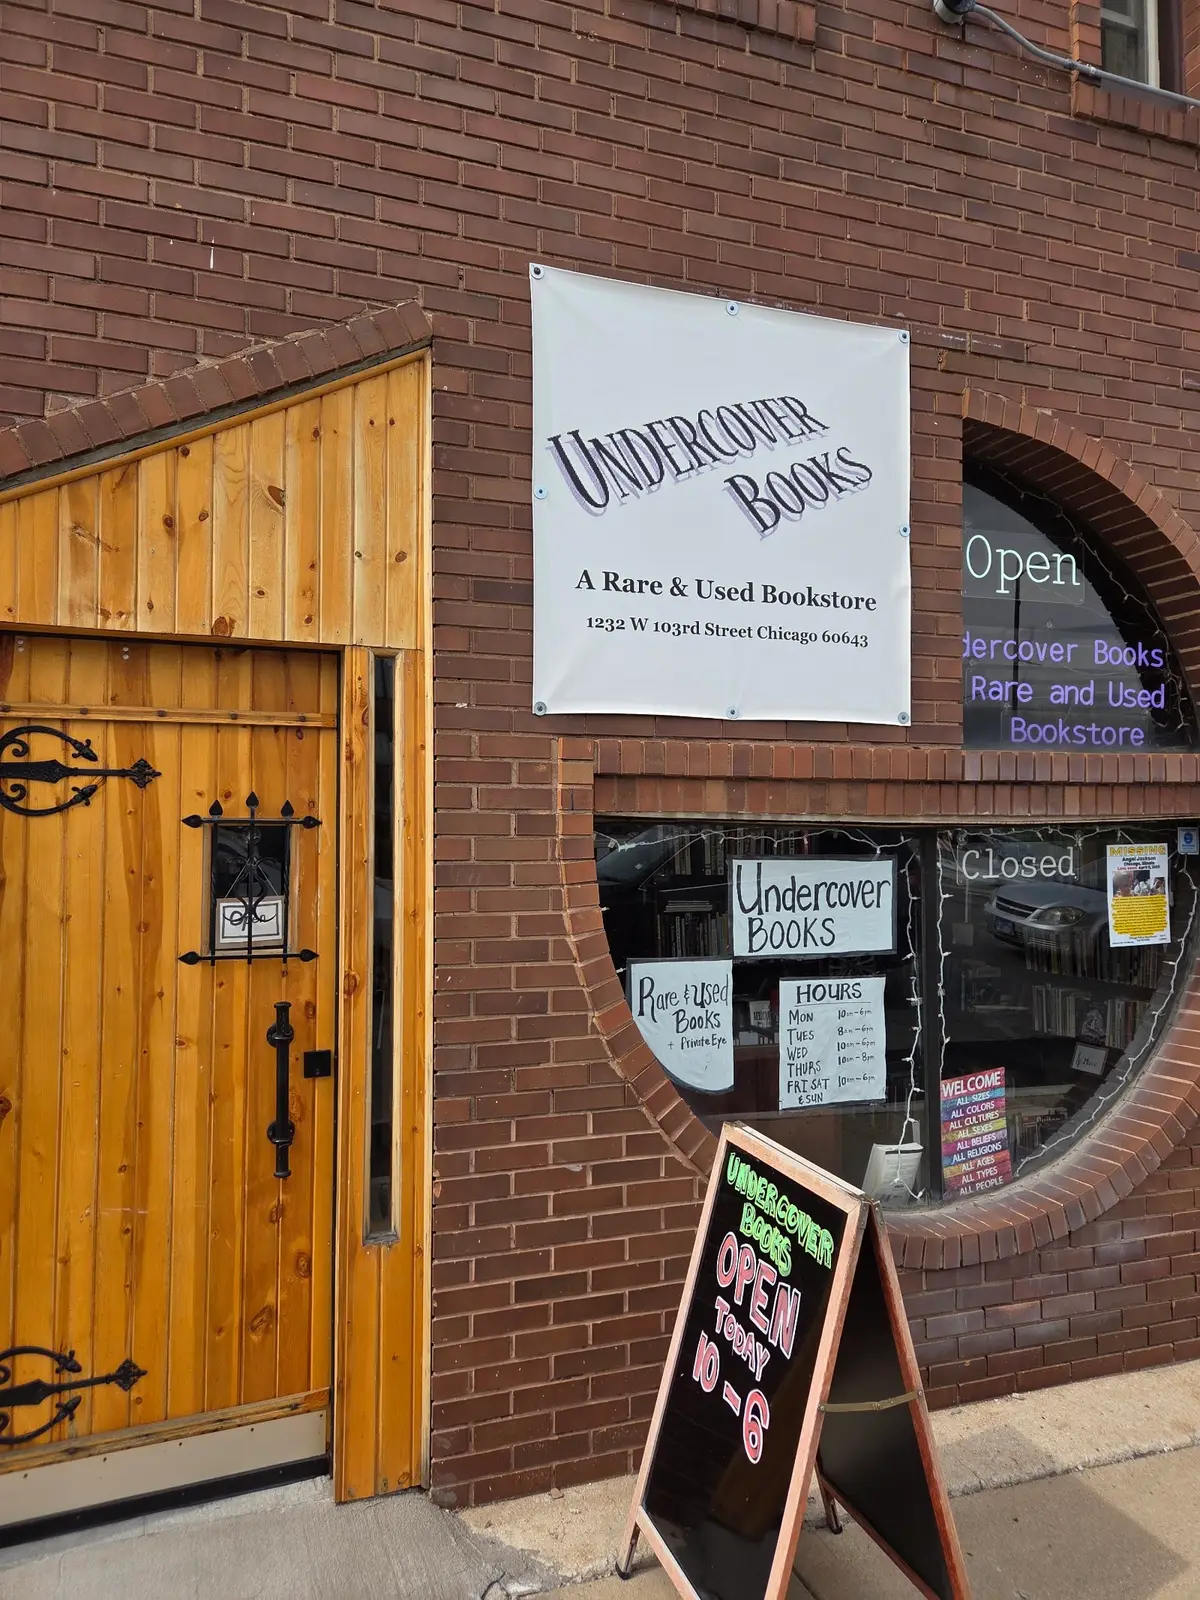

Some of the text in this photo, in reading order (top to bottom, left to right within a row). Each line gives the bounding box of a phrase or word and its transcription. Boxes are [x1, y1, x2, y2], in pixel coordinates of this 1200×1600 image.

[546, 396, 830, 512] UNDERCOVER
[722, 447, 872, 537] BOOKS
[966, 534, 1080, 593] Open
[575, 569, 878, 612] A Rare & Used Bookstore
[586, 616, 869, 649] 1232 W 103rd Street Chicago 60643
[1094, 639, 1164, 668] Books
[971, 675, 1165, 709] Rare and Used
[1010, 716, 1145, 747] Bookstore
[962, 846, 1076, 880] Closed
[1109, 845, 1166, 856] MISSING
[736, 862, 892, 916] Undercover
[748, 916, 836, 954] BOOKS
[637, 976, 680, 1023] Rare
[691, 974, 729, 1009] Used
[796, 982, 862, 1004] HOURS
[672, 1008, 721, 1034] Books
[787, 1046, 808, 1061] WED
[787, 1060, 821, 1078] THURS
[787, 1079, 808, 1094] FRI
[811, 1078, 830, 1090] SAT
[805, 1092, 823, 1104] SUN
[942, 1071, 1001, 1098] WELCOME
[956, 1091, 991, 1106] ALL SIZES
[949, 1109, 1000, 1131] ALL CULTURES
[950, 1100, 996, 1120] ALL COLORS
[956, 1132, 997, 1152] ALL BELIEFS
[957, 1122, 994, 1140] ALL SEXES
[951, 1141, 1002, 1165] ALL RELIGIONS
[961, 1155, 996, 1173] ALL AGES
[959, 1175, 1005, 1197] ALL PEOPLE
[961, 1166, 999, 1185] ALL TYPES
[727, 1152, 835, 1270] UNDERCOVER
[739, 1202, 793, 1277] BOOKS
[716, 1231, 802, 1360] OPEN
[714, 1295, 771, 1382] TODAY
[692, 1329, 720, 1393] 10
[742, 1387, 770, 1464] 6
